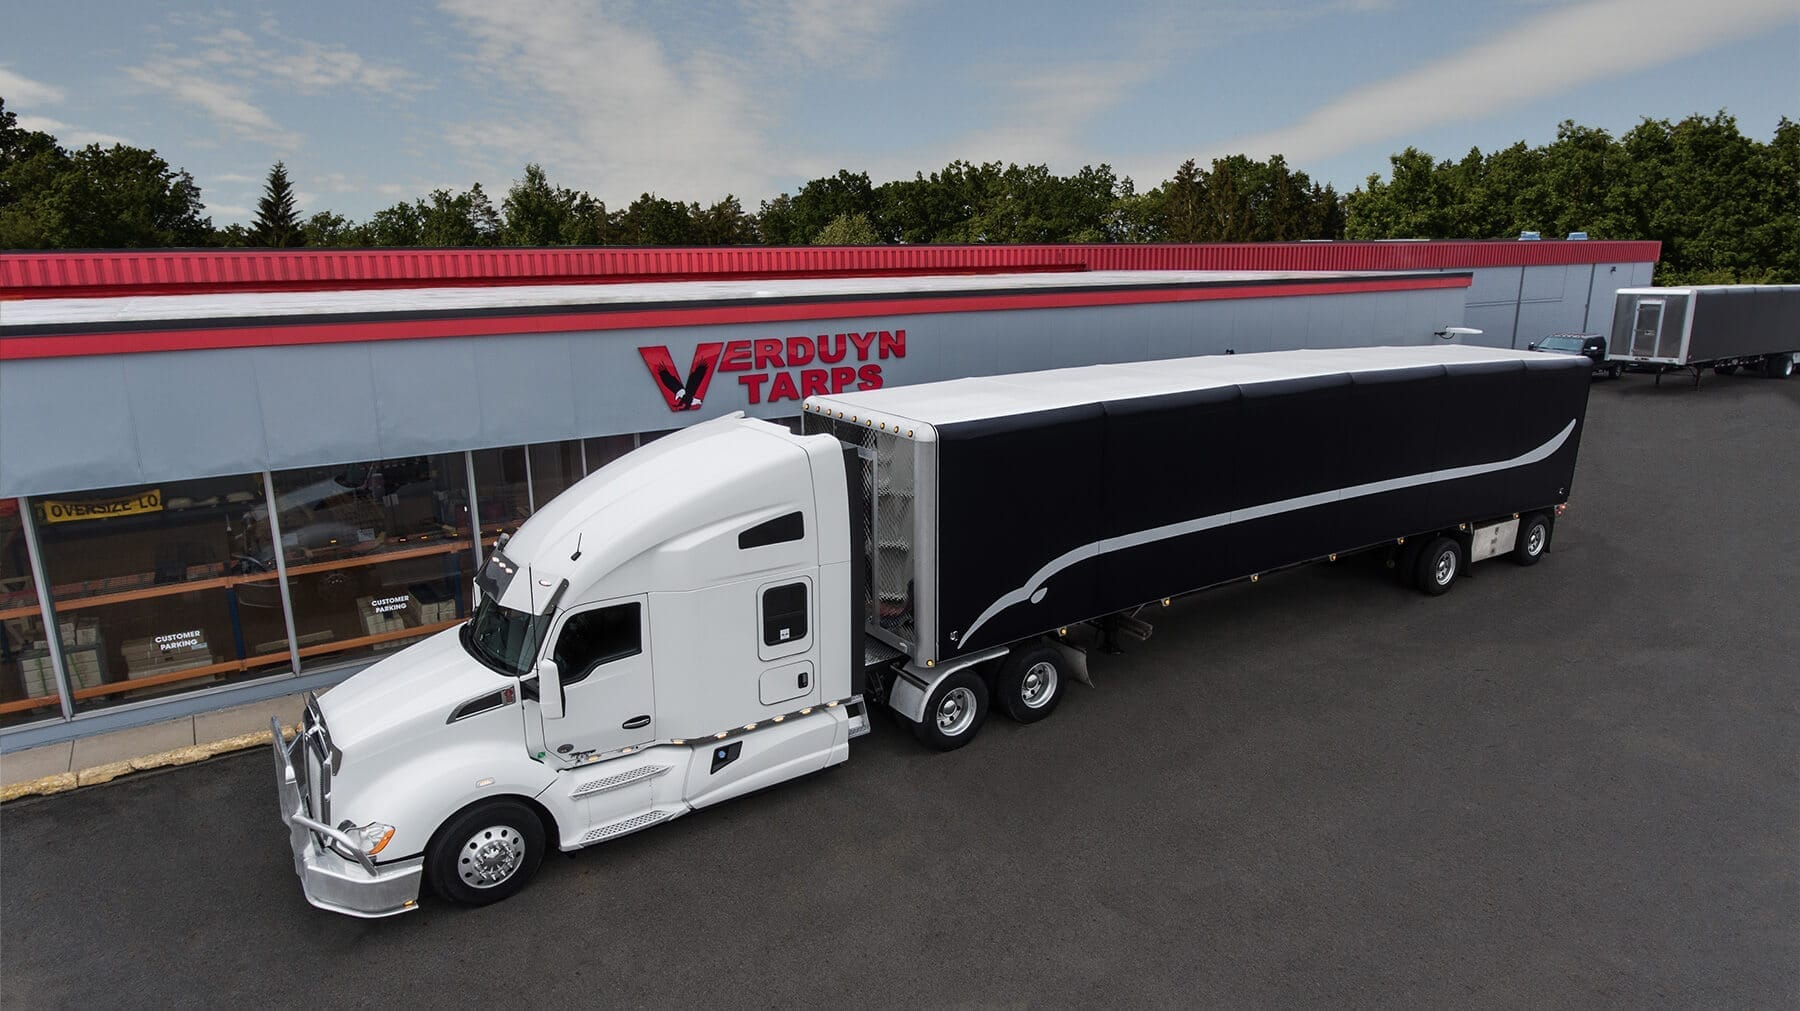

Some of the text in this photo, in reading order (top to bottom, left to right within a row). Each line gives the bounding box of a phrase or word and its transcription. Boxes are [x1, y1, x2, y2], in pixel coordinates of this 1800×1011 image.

[638, 329, 906, 413] VERDUYN
[738, 363, 884, 405] TARPS
[51, 500, 132, 518] OVERSIZE
[371, 595, 409, 607] CUSTOMER
[375, 603, 407, 614] PARKING
[155, 630, 201, 643] CUSTOMER
[160, 639, 198, 651] PARKING
